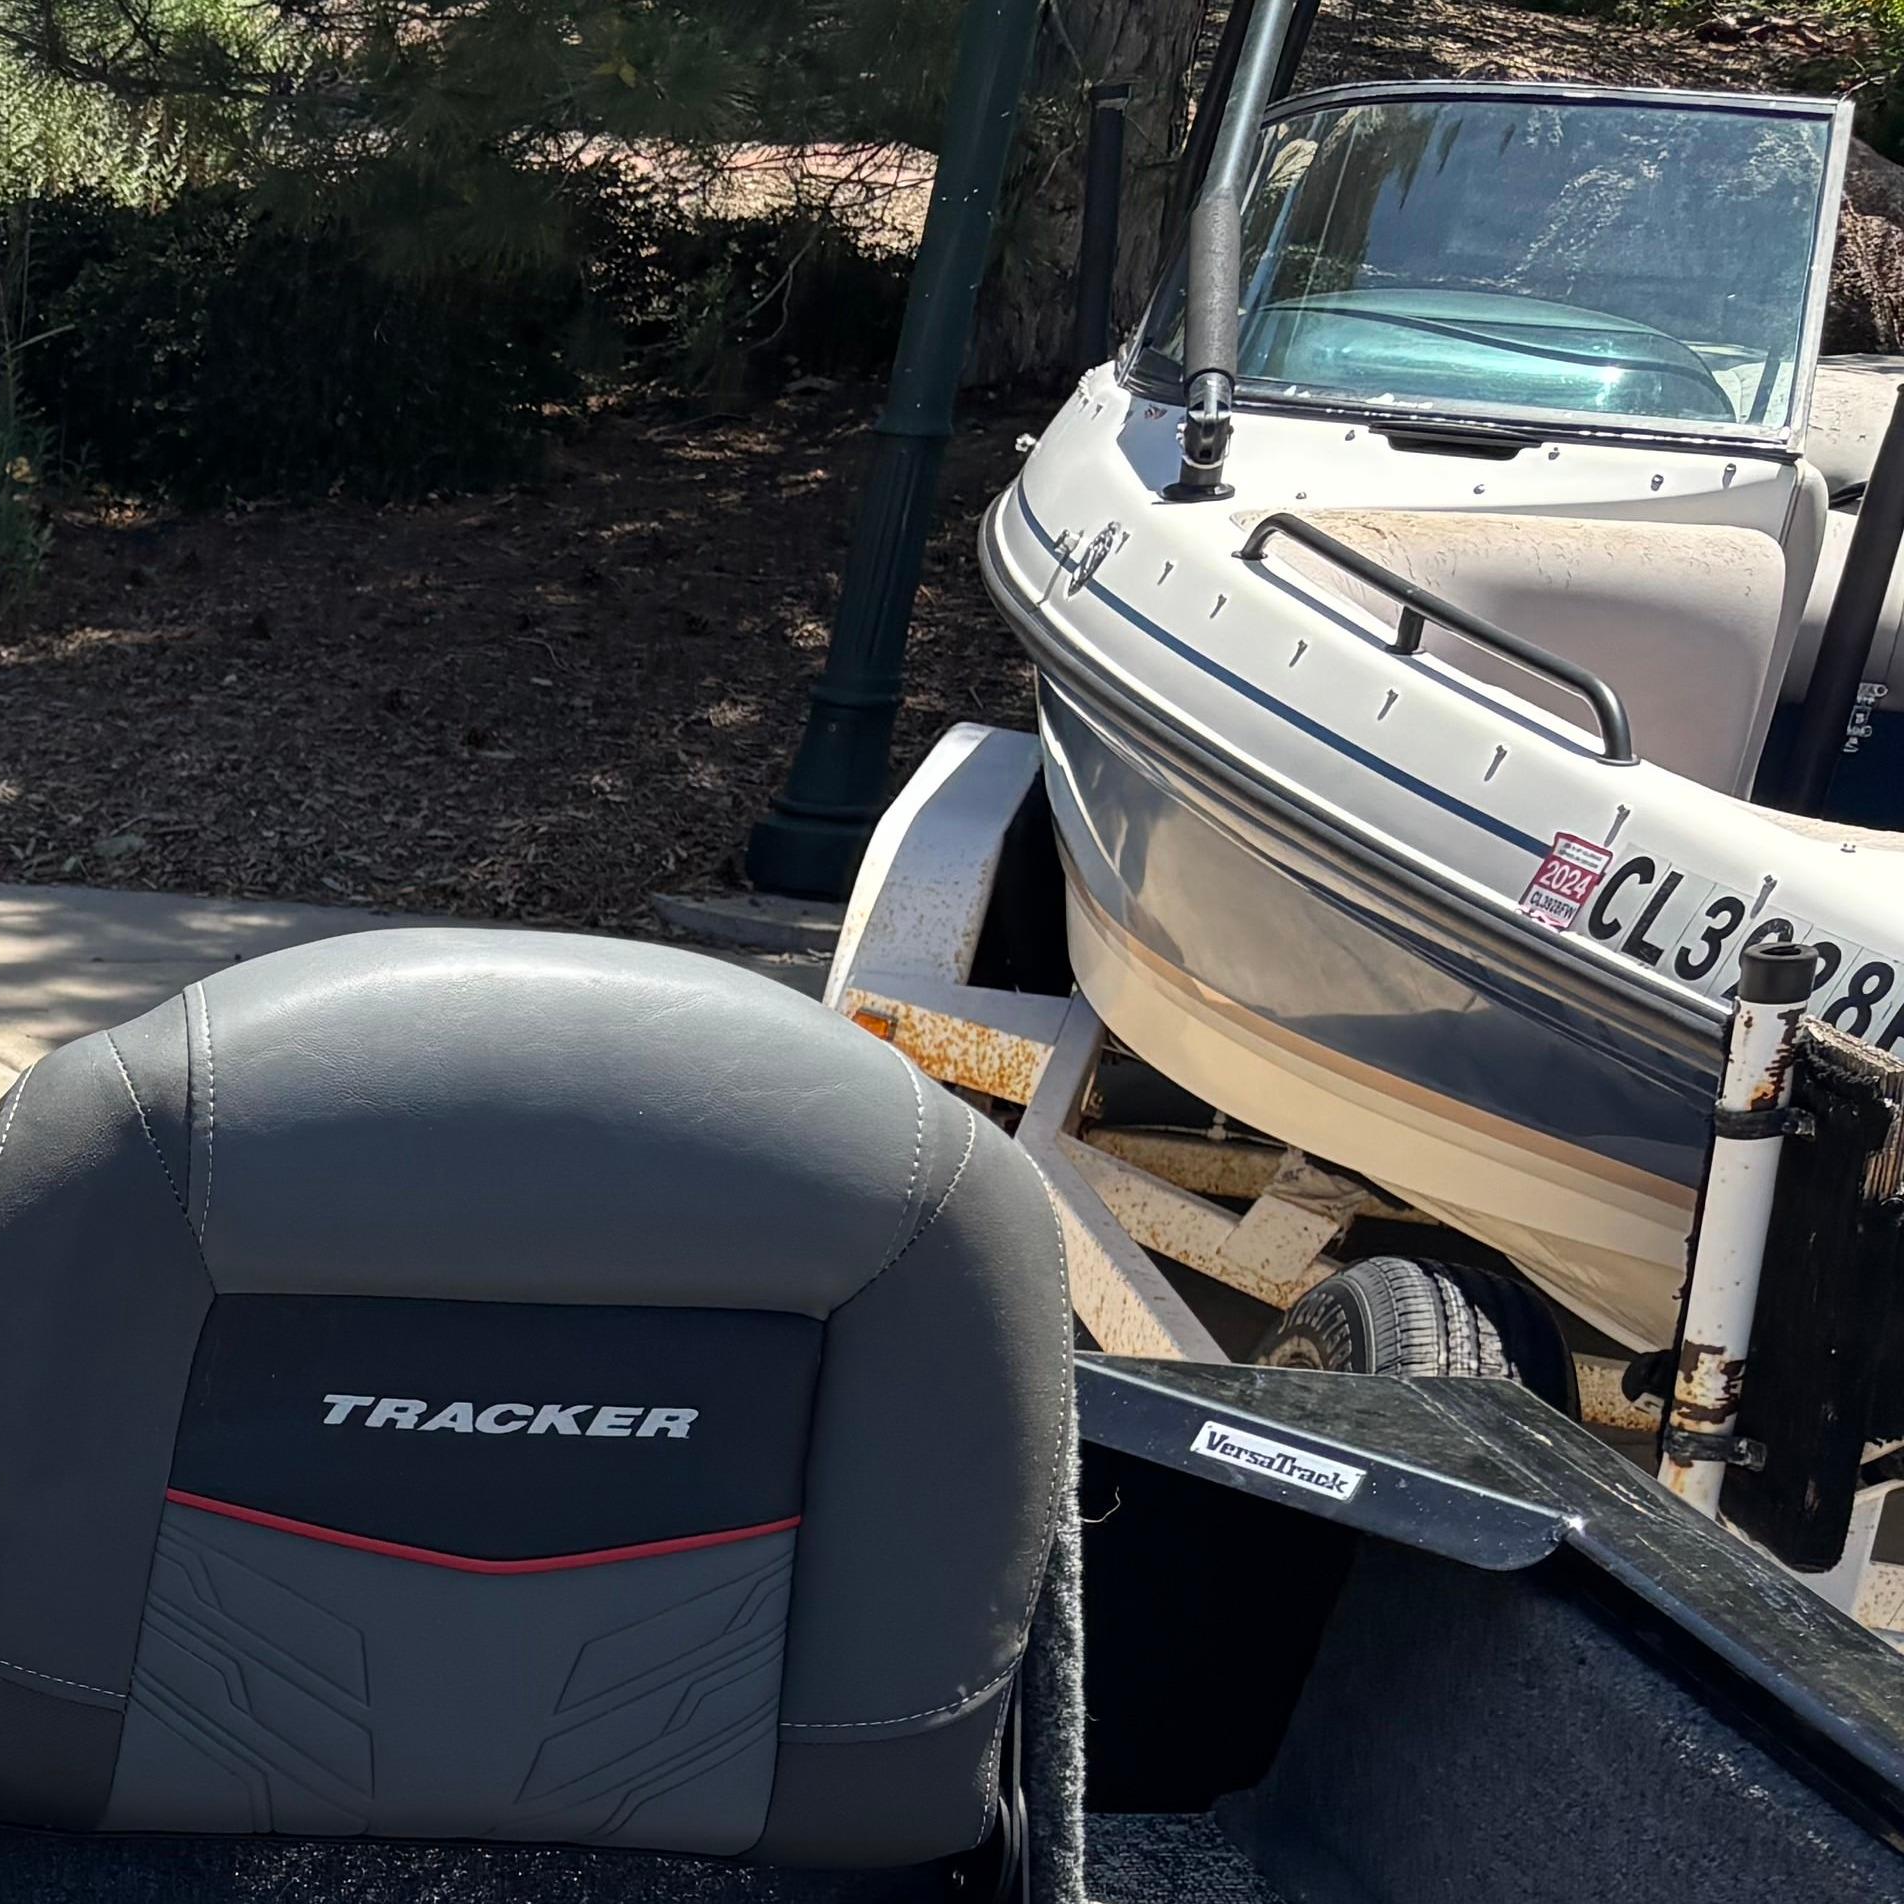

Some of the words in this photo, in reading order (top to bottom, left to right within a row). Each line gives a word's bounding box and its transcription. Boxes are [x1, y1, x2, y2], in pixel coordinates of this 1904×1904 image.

[1539, 860, 1593, 899] 2024
[323, 1394, 700, 1439] TRACKER
[1205, 1430, 1350, 1493] VersaTrack
